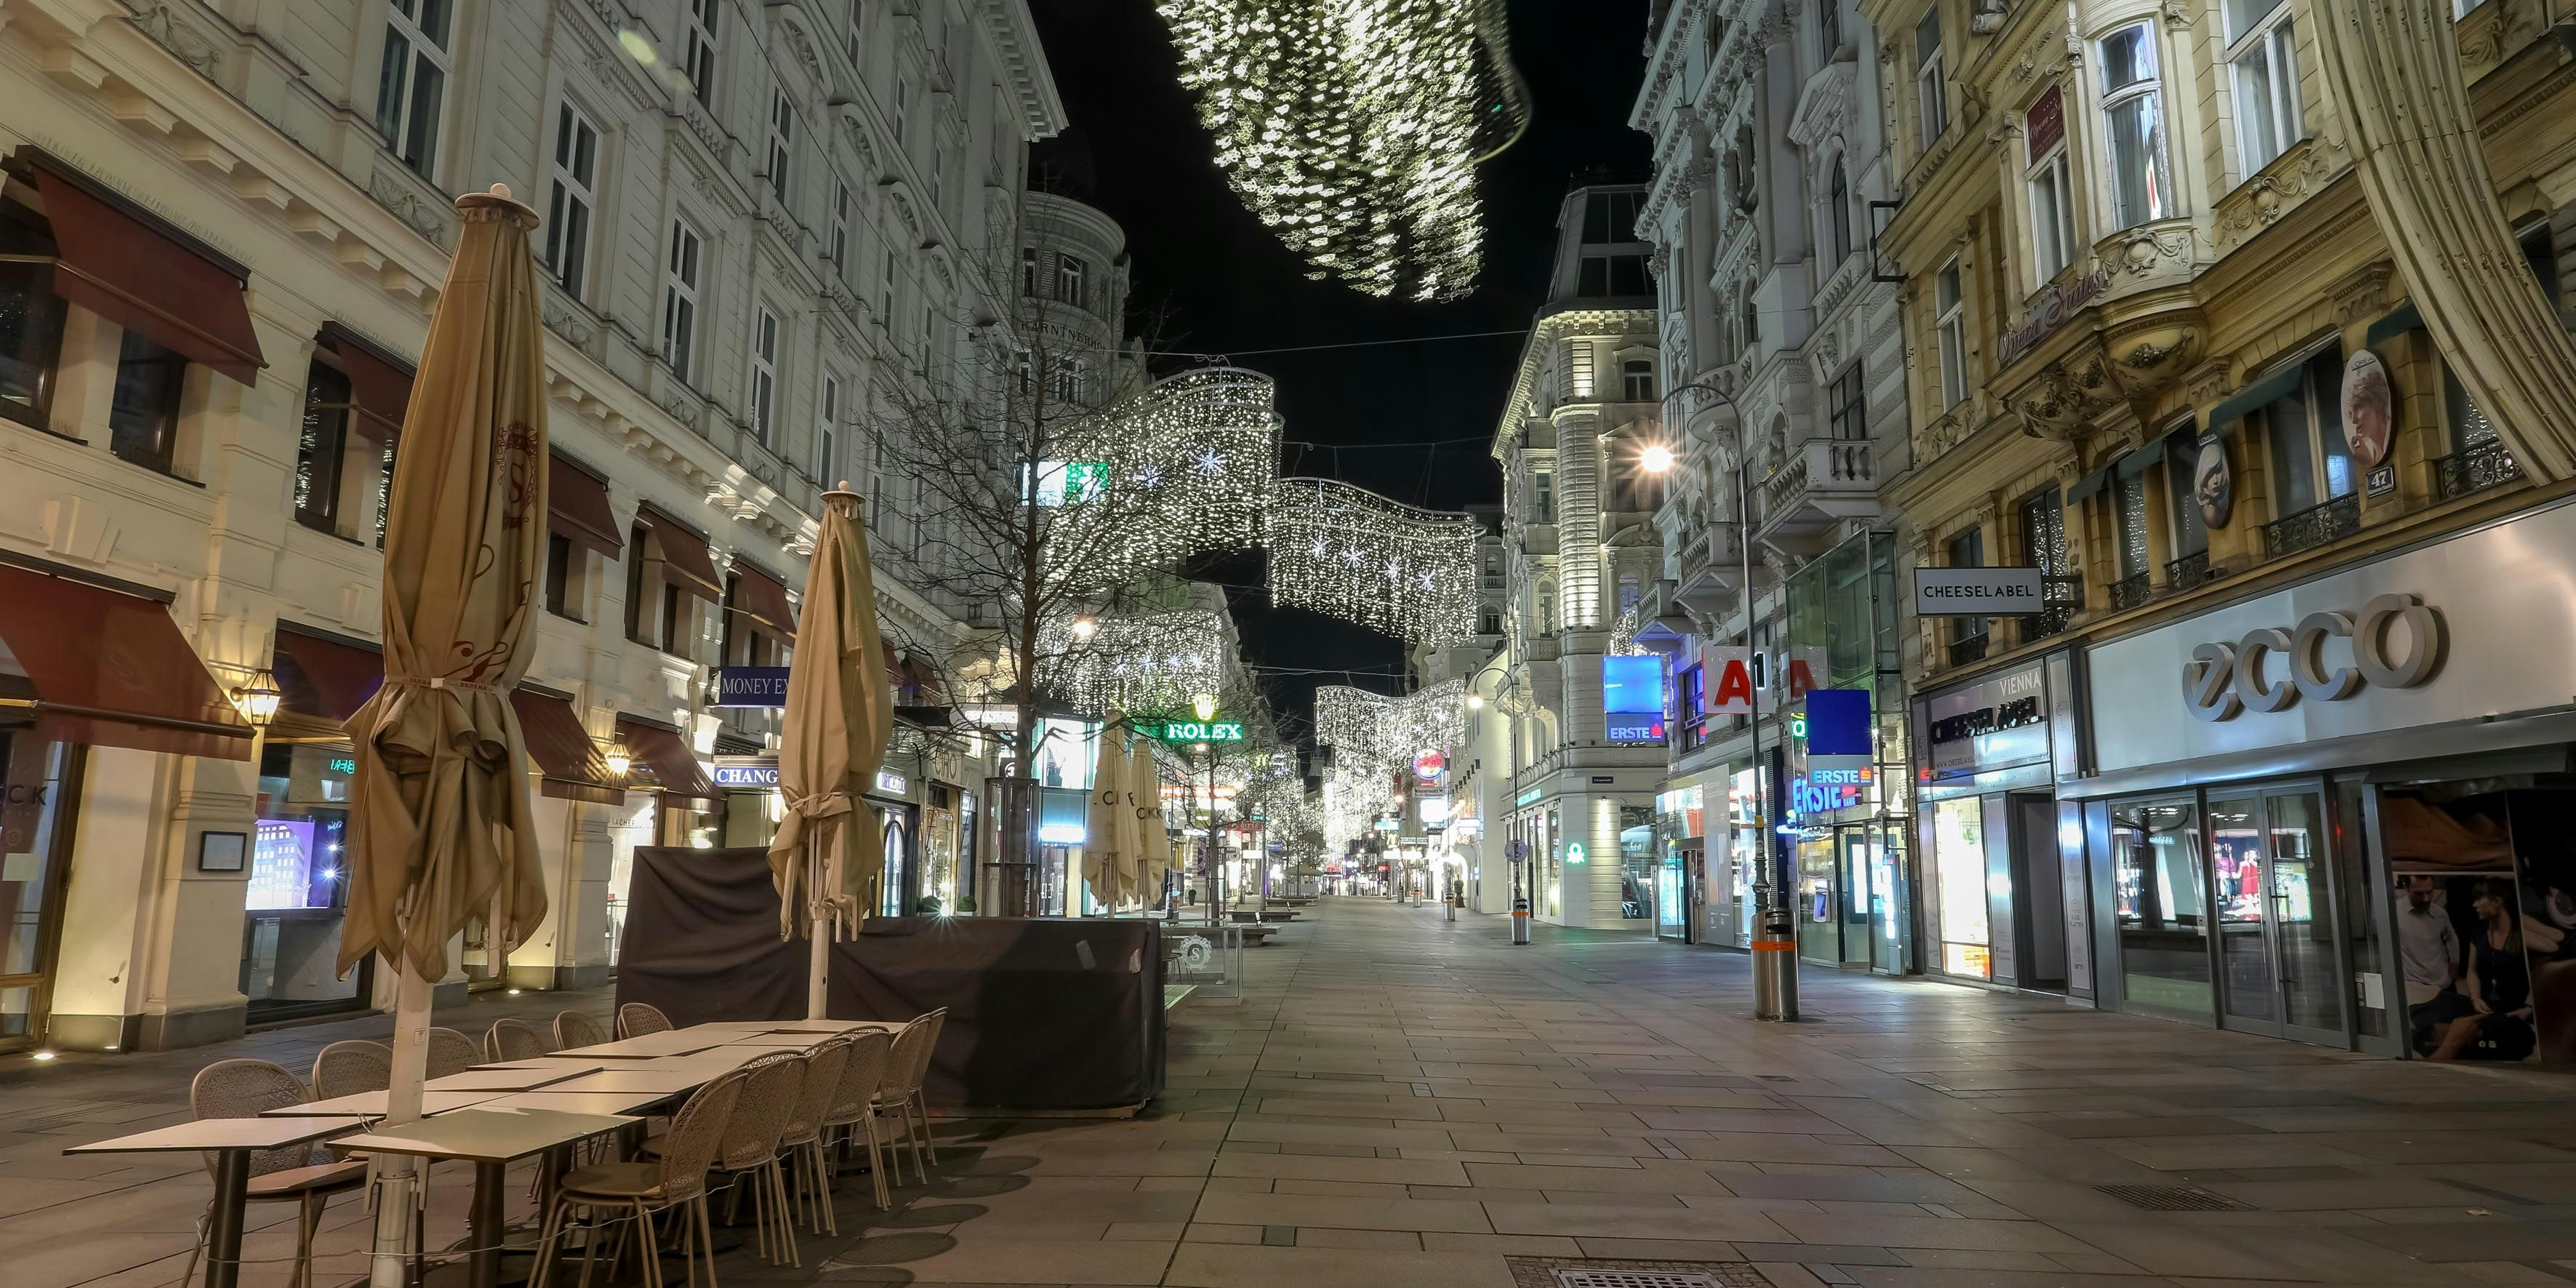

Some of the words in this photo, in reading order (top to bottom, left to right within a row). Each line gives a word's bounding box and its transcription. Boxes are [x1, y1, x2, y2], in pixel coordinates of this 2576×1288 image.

[1997, 319, 2042, 364] Opera
[2371, 470, 2387, 487] 47
[1924, 585, 2034, 598] CHEESELABEL
[2183, 593, 2438, 722] ecco
[723, 678, 771, 695] MONEY
[2000, 671, 2042, 696] VIENNA
[1168, 723, 1243, 739] ROLEX
[1610, 727, 1650, 739] ERSTE
[716, 769, 779, 784] CHANG
[1813, 769, 1858, 784] ERSTE
[0, 785, 47, 806] CK
[1192, 947, 1200, 961] S
